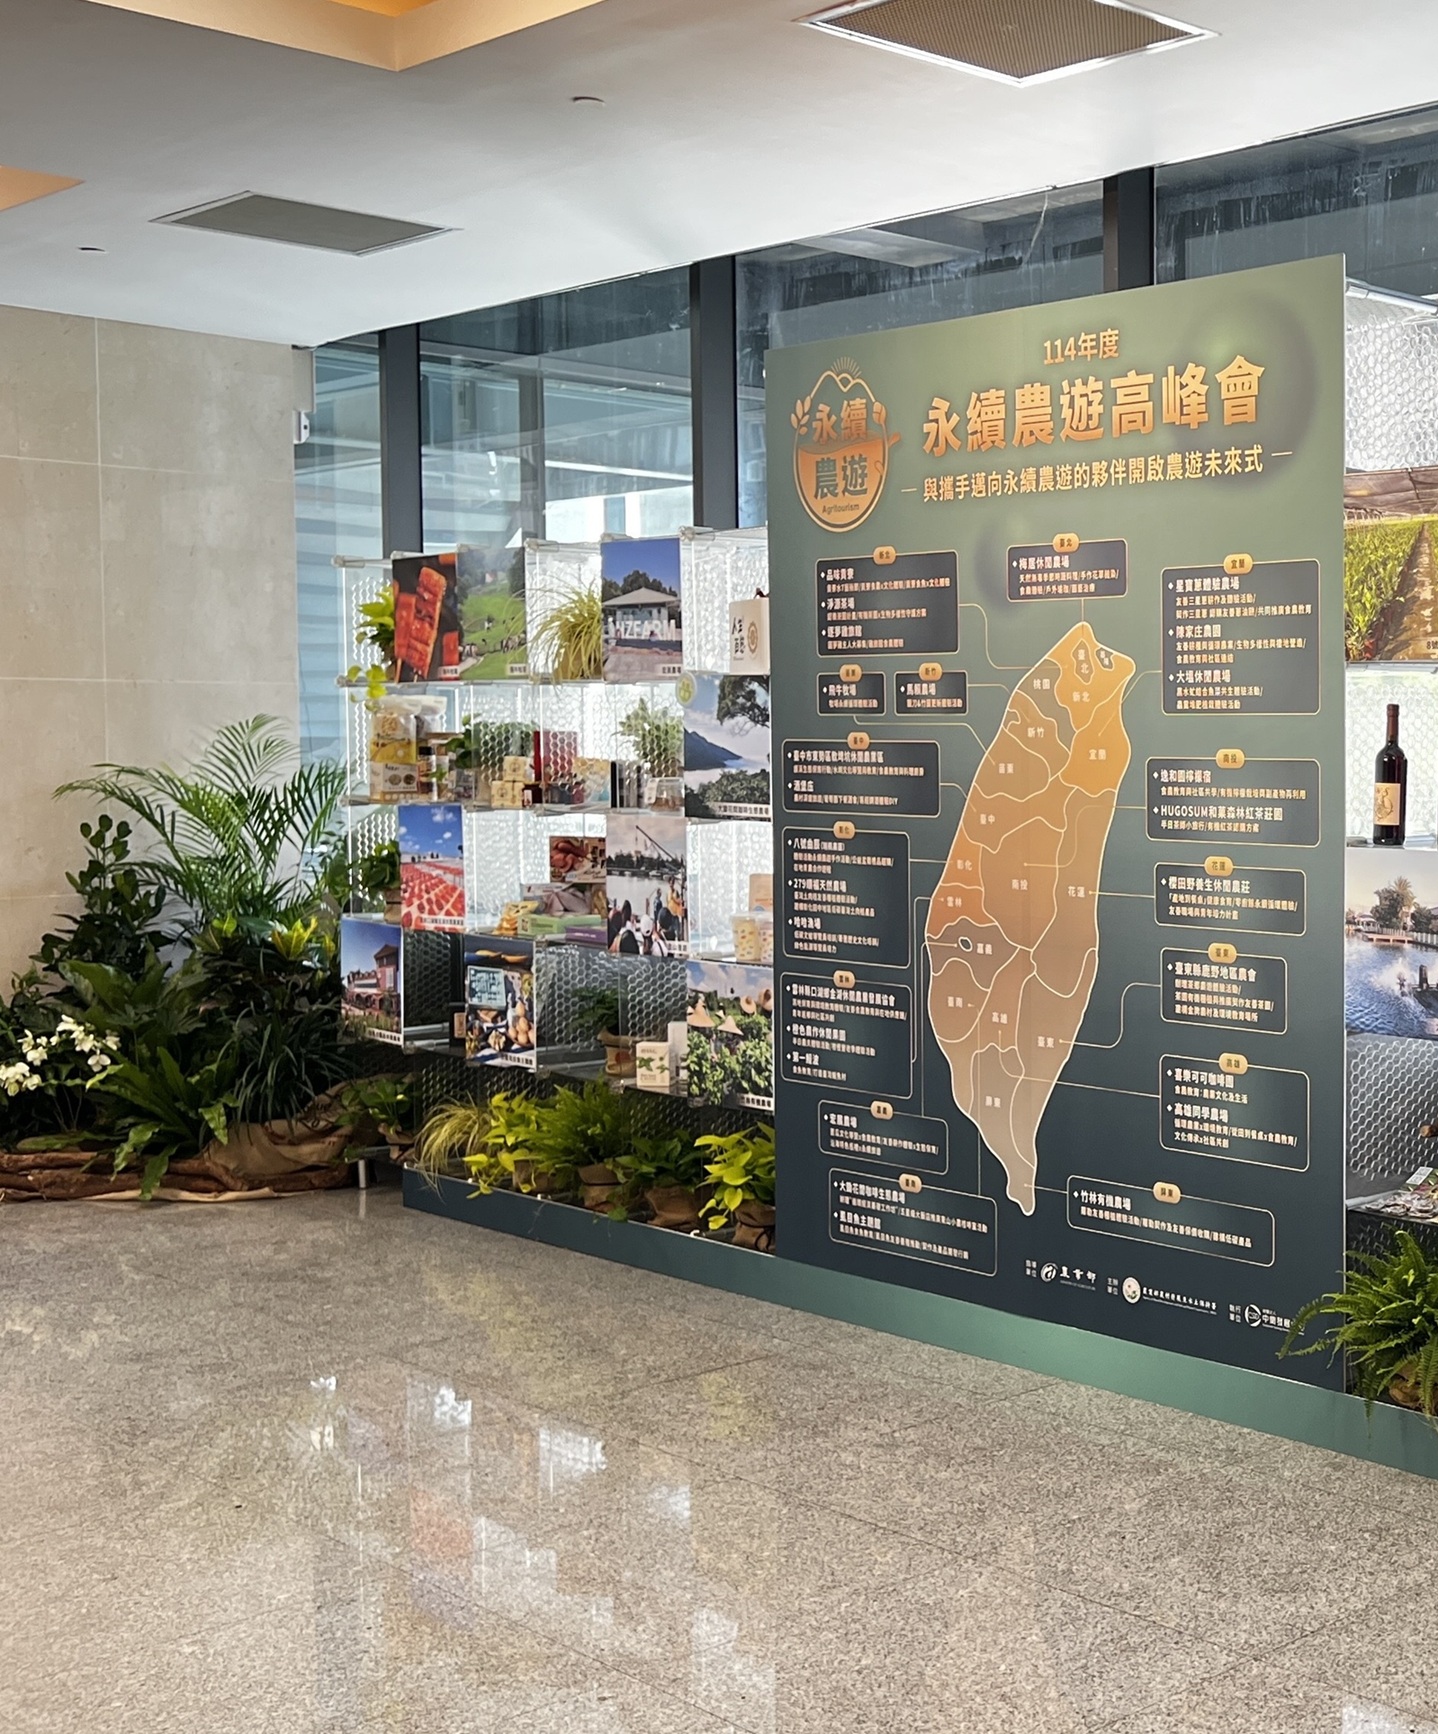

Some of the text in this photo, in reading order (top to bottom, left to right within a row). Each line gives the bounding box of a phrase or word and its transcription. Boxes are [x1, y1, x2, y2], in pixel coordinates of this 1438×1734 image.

[1043, 329, 1119, 365] 114年度
[922, 355, 1265, 456] 永續農遊高峰會
[812, 398, 867, 445] 永續
[814, 454, 867, 499] 農遊
[924, 444, 1263, 502] 與攜手邁向永續農遊的夥伴開啟農遊未來式
[822, 504, 859, 514] Agritourism
[1033, 679, 1050, 689] 桃園
[1073, 692, 1090, 702] 新北
[1027, 727, 1044, 738] 新竹
[1089, 749, 1106, 760] 宜蘭
[1161, 805, 1283, 821] HUGOSUM和菓森林紅茶莊園
[957, 860, 972, 870] 彰化
[1012, 879, 1028, 890] 南投
[1068, 886, 1085, 897] 花蓮
[1175, 1103, 1228, 1123] 高雄同學農場
[1081, 1190, 1131, 1212] 竹林有機農場
